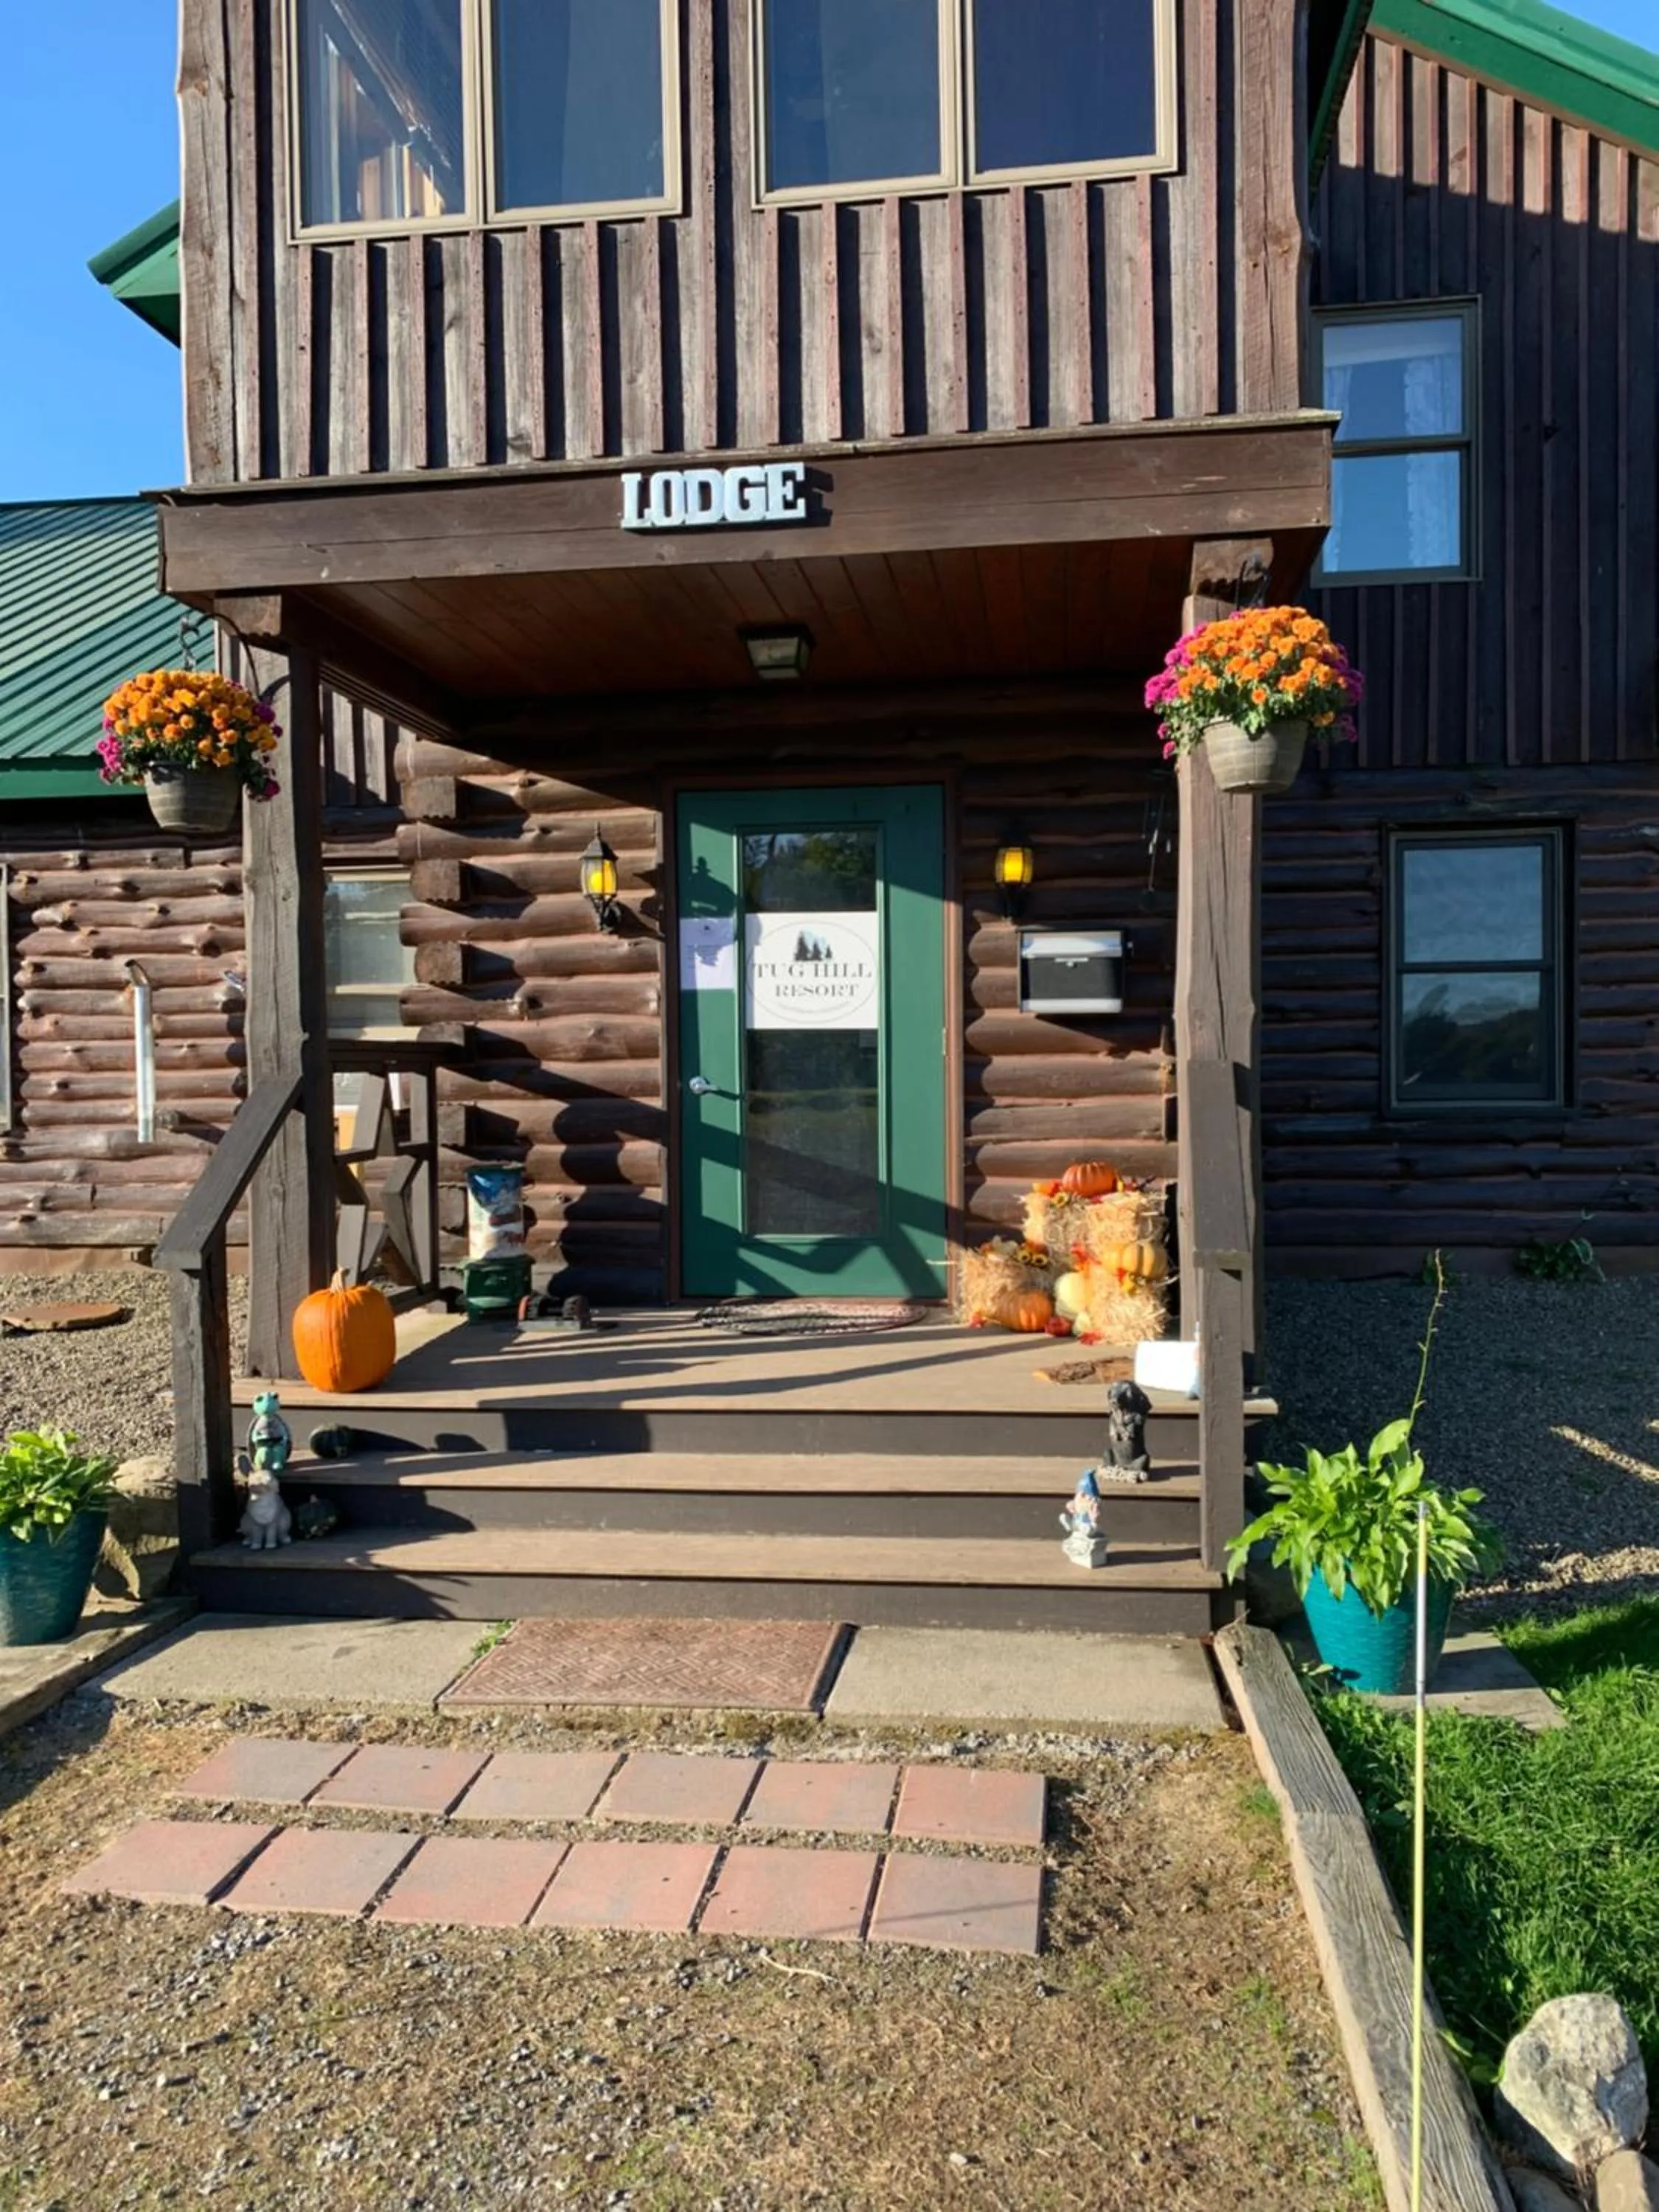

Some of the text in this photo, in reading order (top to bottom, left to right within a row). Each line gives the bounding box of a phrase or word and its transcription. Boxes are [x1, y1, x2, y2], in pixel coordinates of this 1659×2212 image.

[620, 461, 806, 529] LODGE
[753, 962, 872, 978] TUG HILL
[775, 984, 860, 997] RESORT
